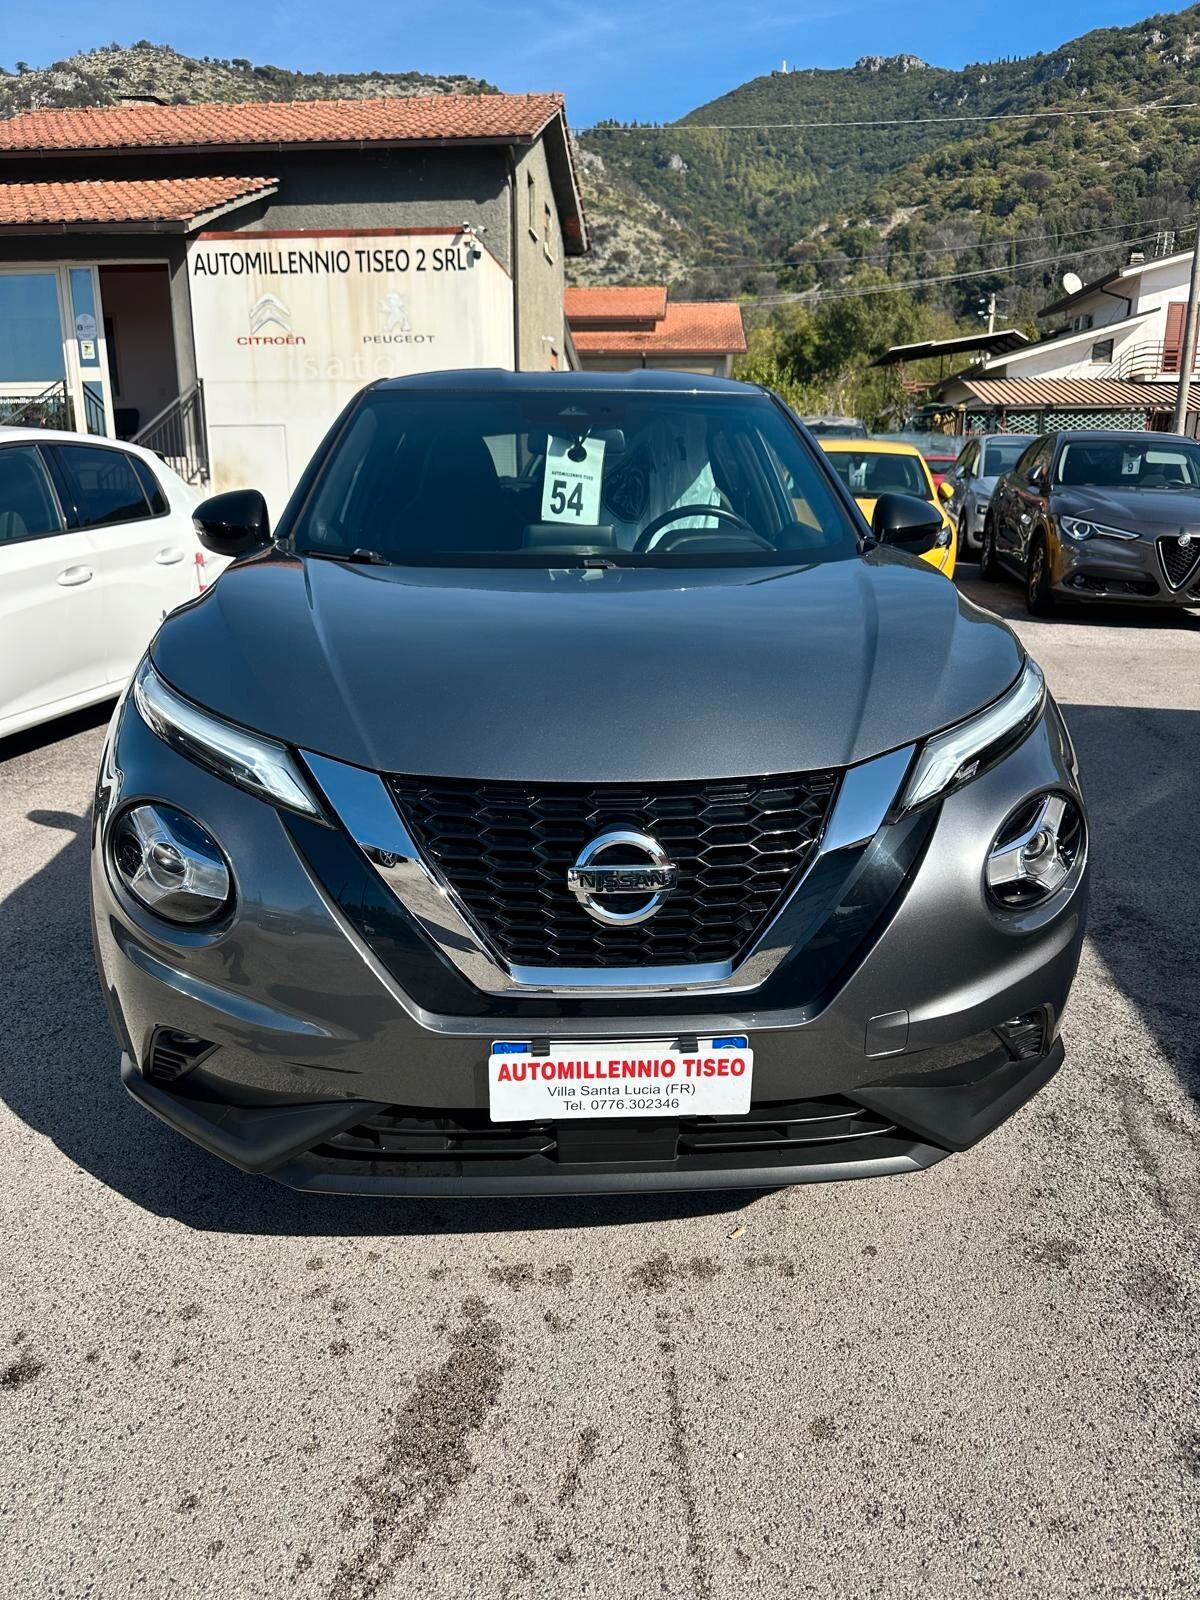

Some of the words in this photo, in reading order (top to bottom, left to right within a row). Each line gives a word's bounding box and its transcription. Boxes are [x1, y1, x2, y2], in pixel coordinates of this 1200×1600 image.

[194, 250, 350, 275] AUTOMILLENNIO
[355, 249, 410, 273] TISEO
[416, 249, 426, 272] 2
[433, 248, 466, 271] SRL
[363, 335, 435, 344] PEUGEOT
[1128, 463, 1134, 473] 9
[550, 479, 583, 516] 54
[579, 870, 663, 891] NISSAN
[497, 1060, 675, 1081] AUTOMILLENNIO
[682, 1058, 746, 1077] TISEO
[547, 1086, 576, 1097] Villa
[580, 1085, 620, 1096] Santa
[625, 1084, 661, 1095] Lucia
[665, 1083, 696, 1096] (FR)
[563, 1100, 586, 1111] Tel.
[590, 1098, 680, 1110] 0776.302346
